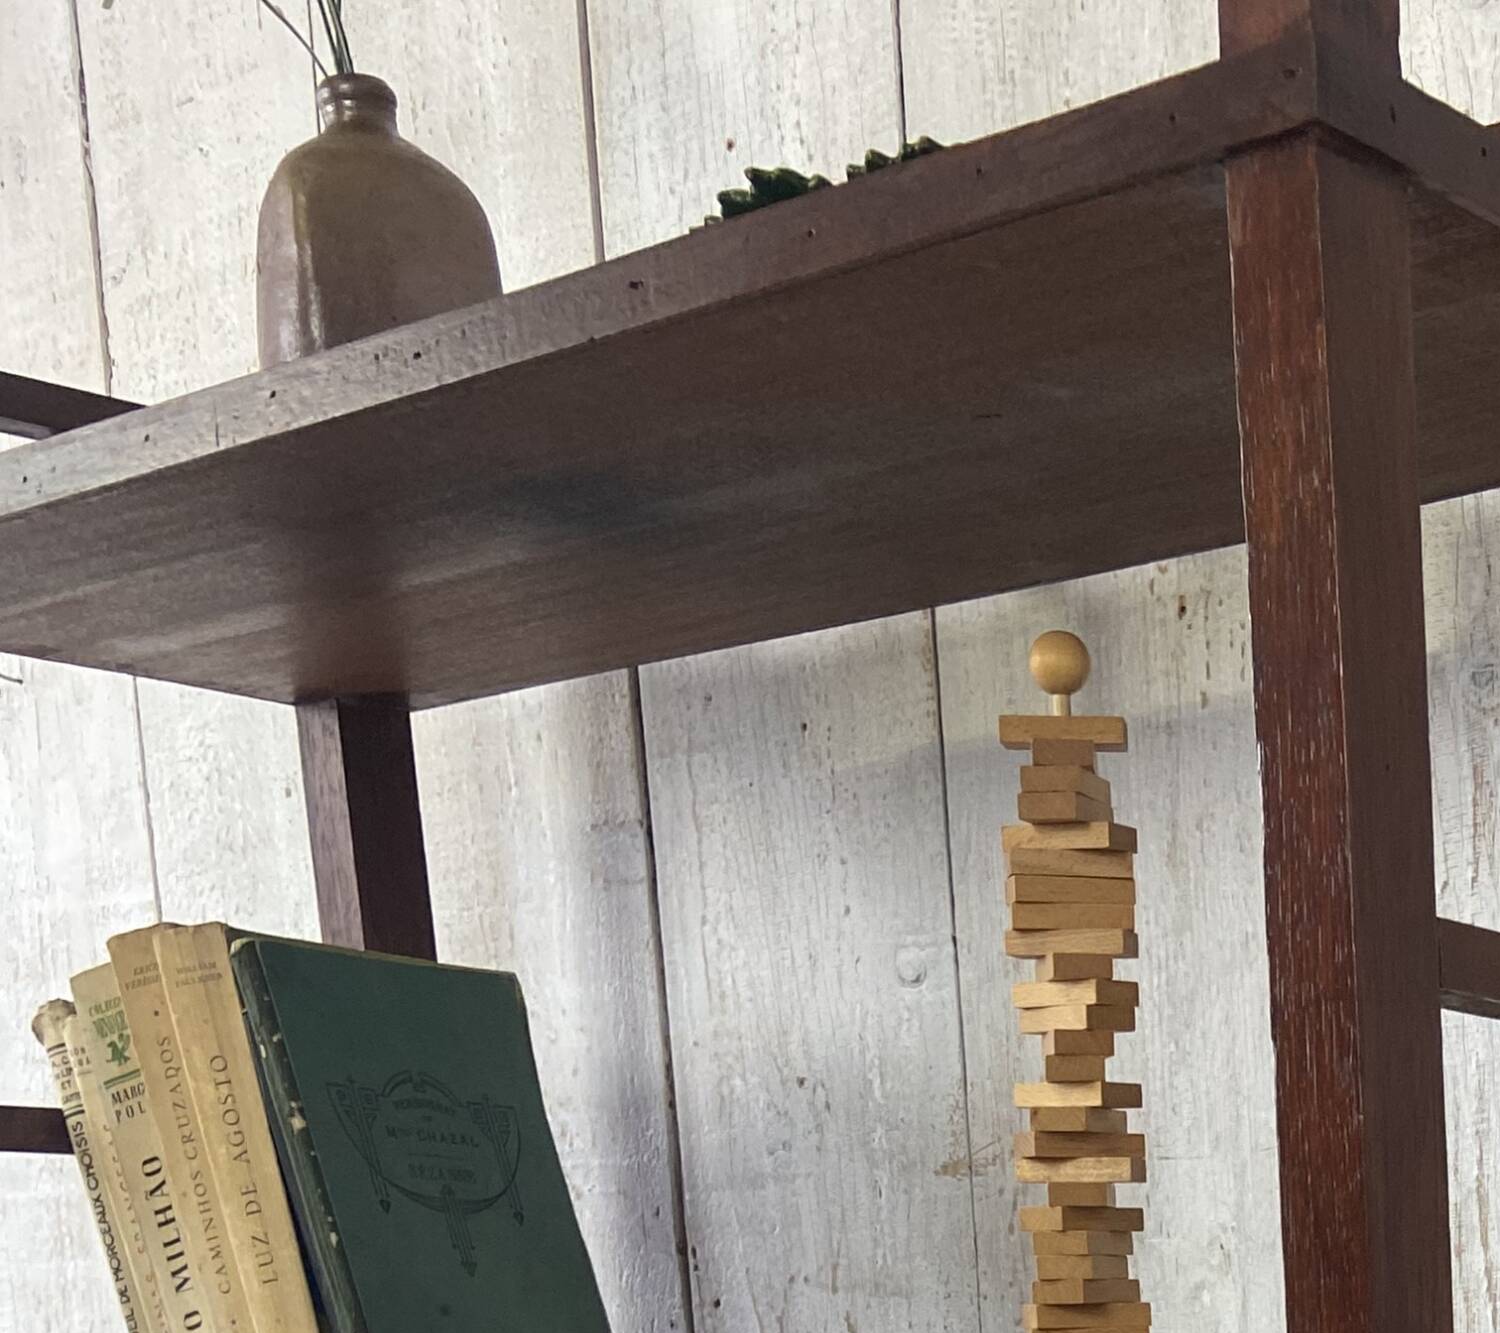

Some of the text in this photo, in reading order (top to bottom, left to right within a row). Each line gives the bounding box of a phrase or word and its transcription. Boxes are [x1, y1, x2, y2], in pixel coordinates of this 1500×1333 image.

[92, 1193, 124, 1282] MORCEAUX
[142, 1156, 203, 1331] O MILHÃO
[157, 1036, 232, 1295] CAMINHOS CRUZADOS
[209, 1055, 279, 1286] LUZ DE AGOSTO
[117, 1285, 131, 1304] DE
